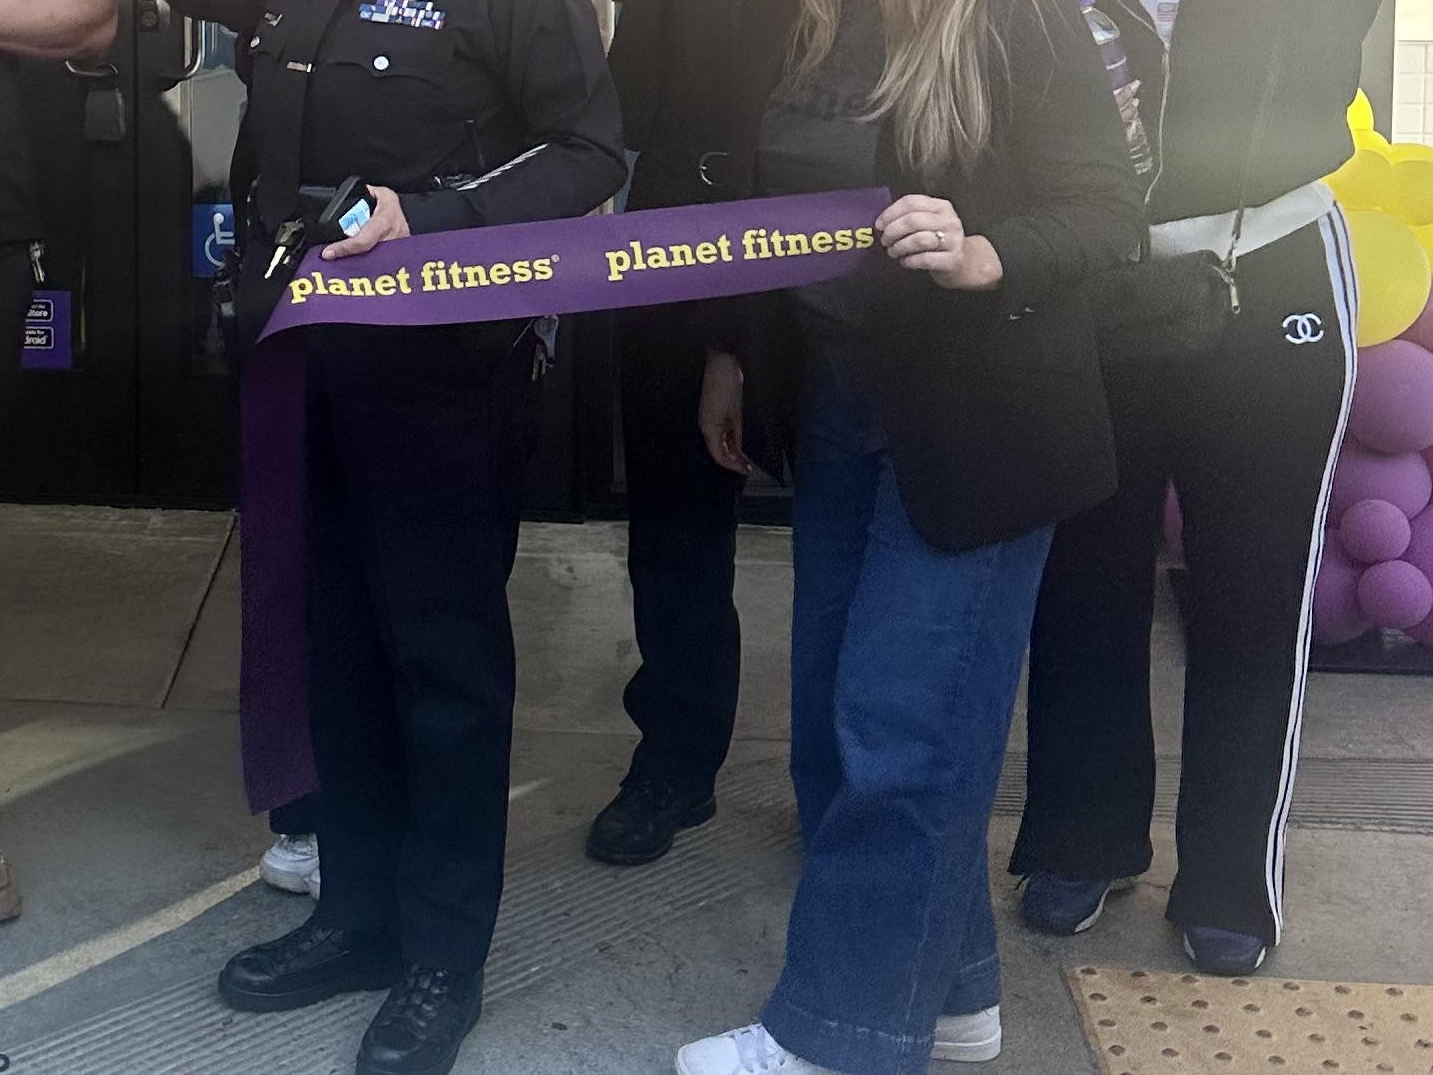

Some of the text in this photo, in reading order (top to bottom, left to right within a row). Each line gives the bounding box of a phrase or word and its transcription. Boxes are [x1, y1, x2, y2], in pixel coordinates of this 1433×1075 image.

[288, 266, 412, 305] planet
[605, 233, 733, 282] planet
[742, 226, 875, 260] fitness
